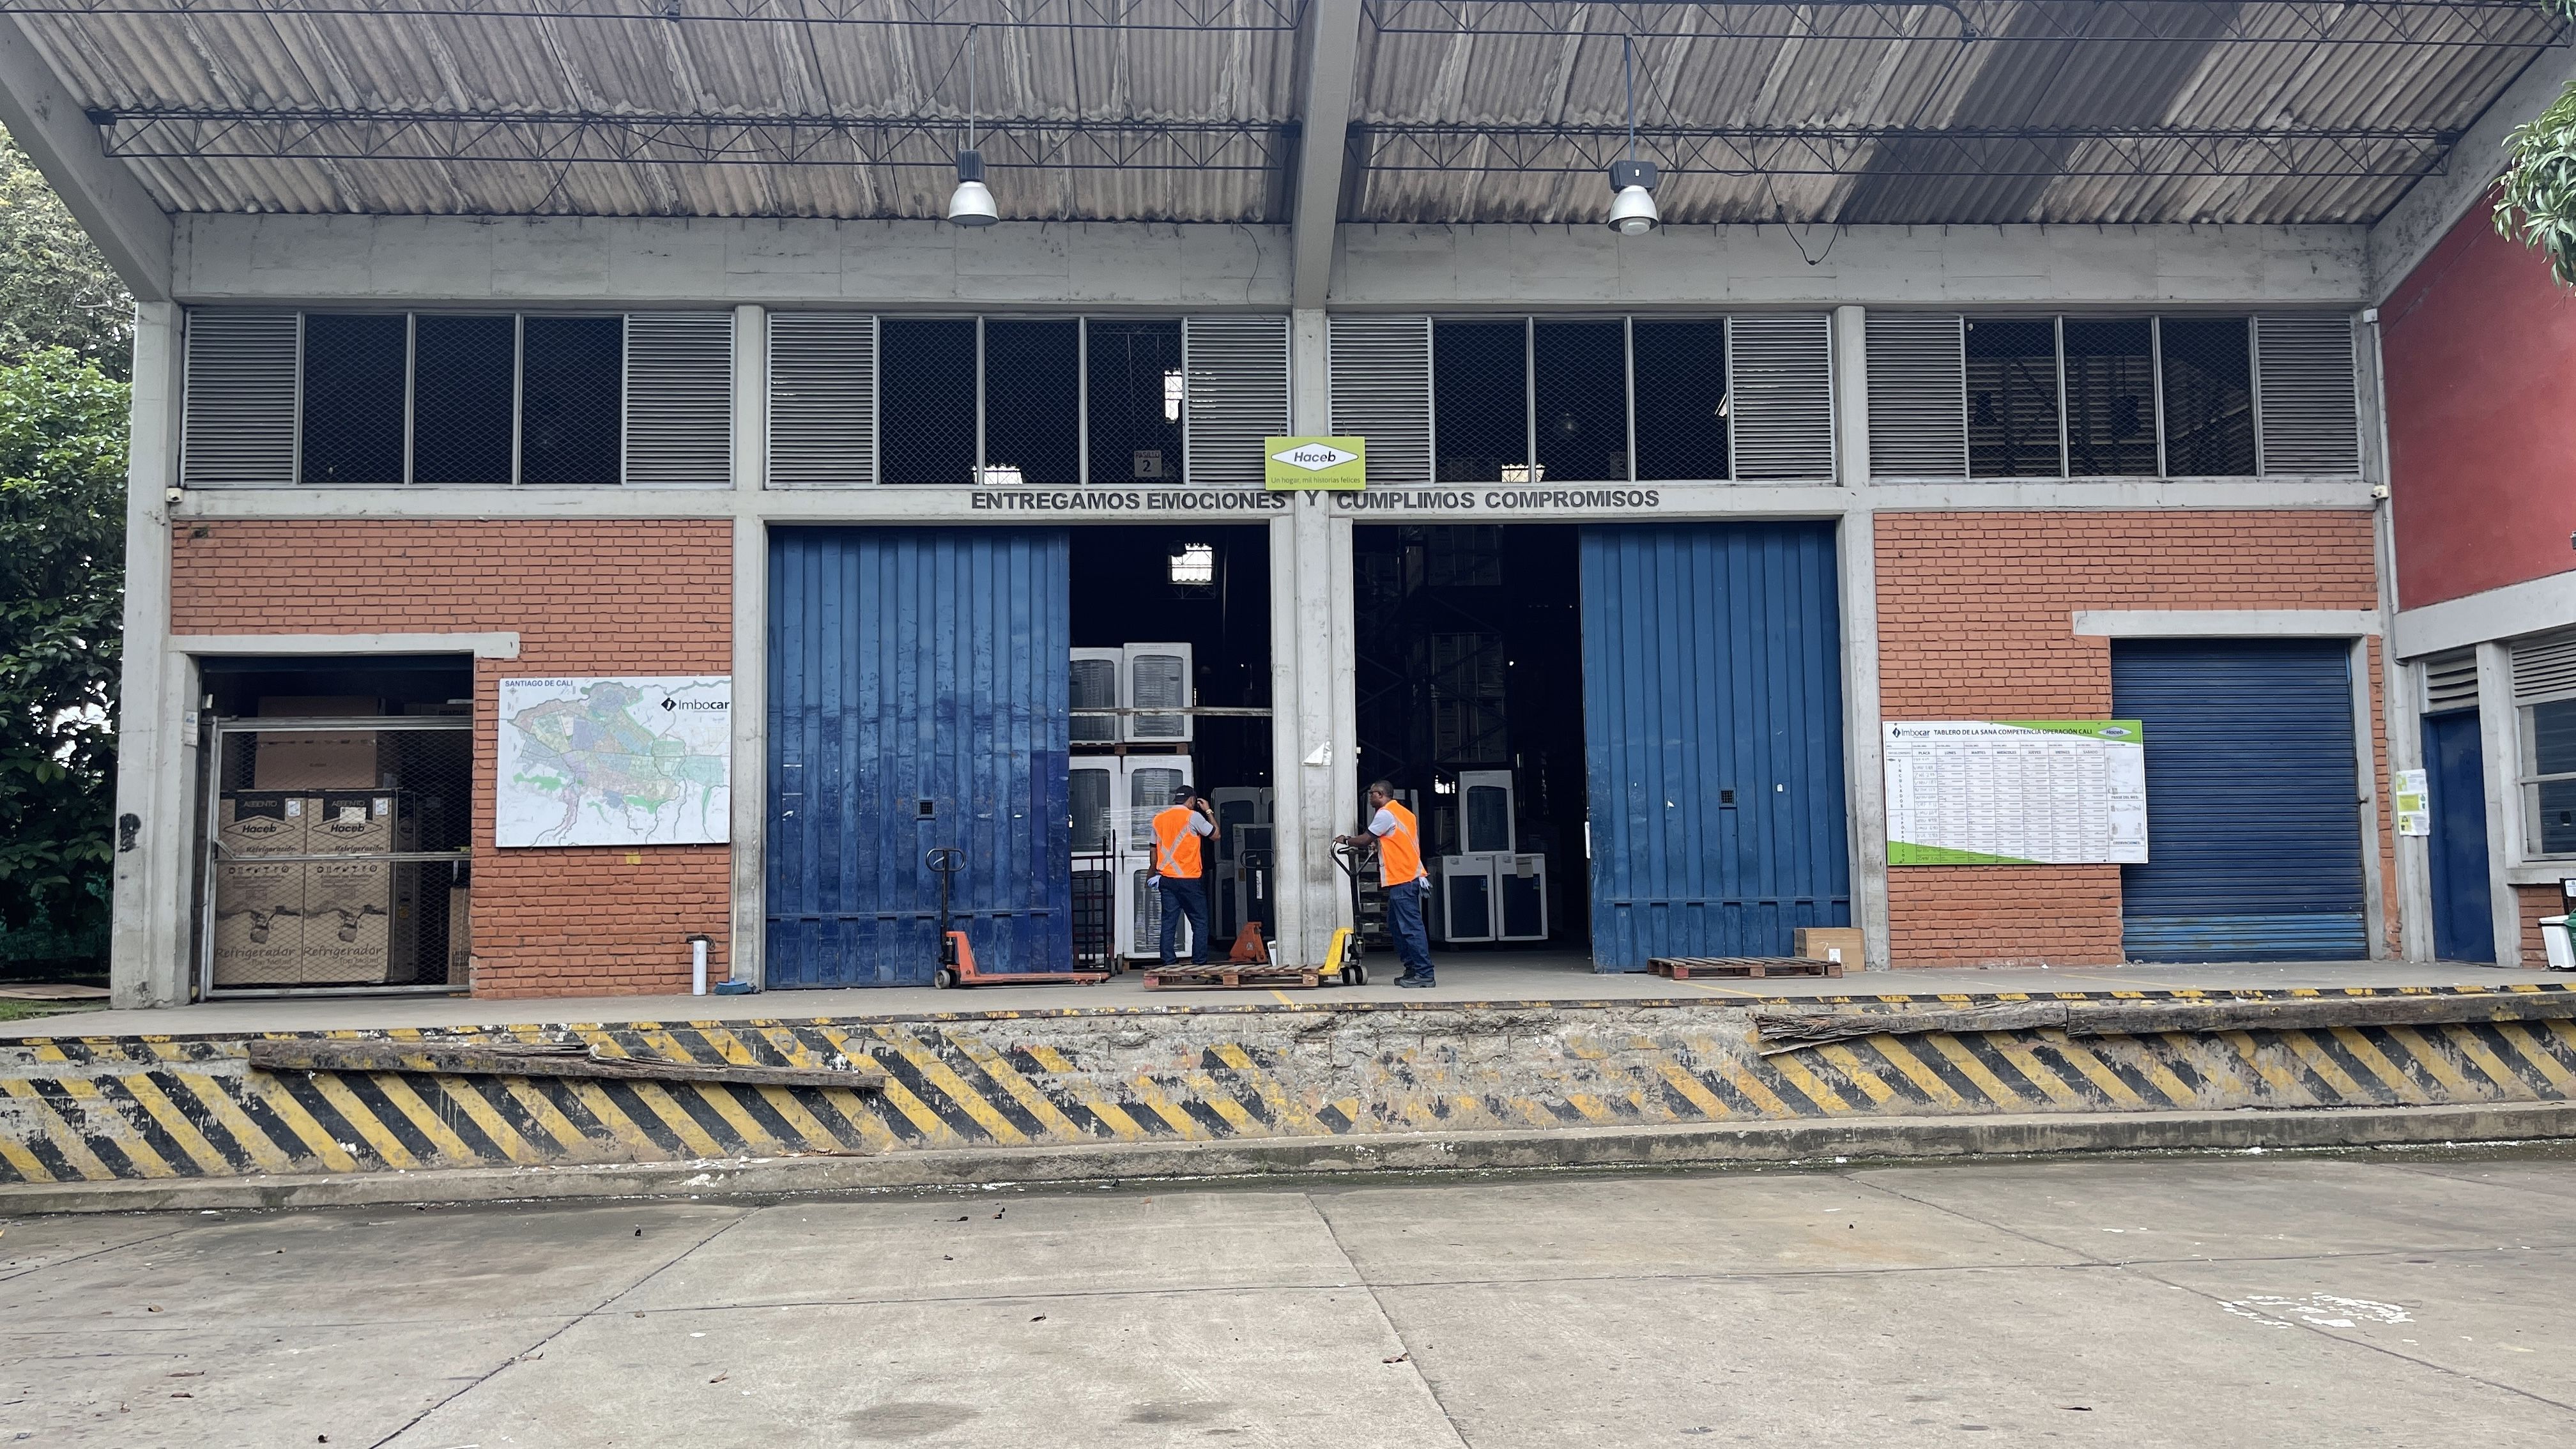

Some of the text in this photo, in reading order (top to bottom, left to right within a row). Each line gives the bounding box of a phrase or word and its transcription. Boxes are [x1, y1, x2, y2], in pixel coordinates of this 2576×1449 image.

[1294, 450, 1336, 462] Haceb
[1143, 459, 1151, 472] 2
[1282, 477, 1301, 485] hogar,
[1340, 475, 1360, 484] felices
[971, 490, 1660, 510] ENTREGAMOS EMOCIONES Y CUMPLIMOS COMPROMISOS
[678, 699, 730, 710] Imbocar
[1901, 728, 1930, 737] Imbocar
[242, 823, 277, 833] Haceb
[331, 823, 365, 832] Haceb
[335, 844, 385, 854] Refrigeración
[217, 946, 296, 960] Refrigerador
[303, 944, 383, 959] Refrigerador
